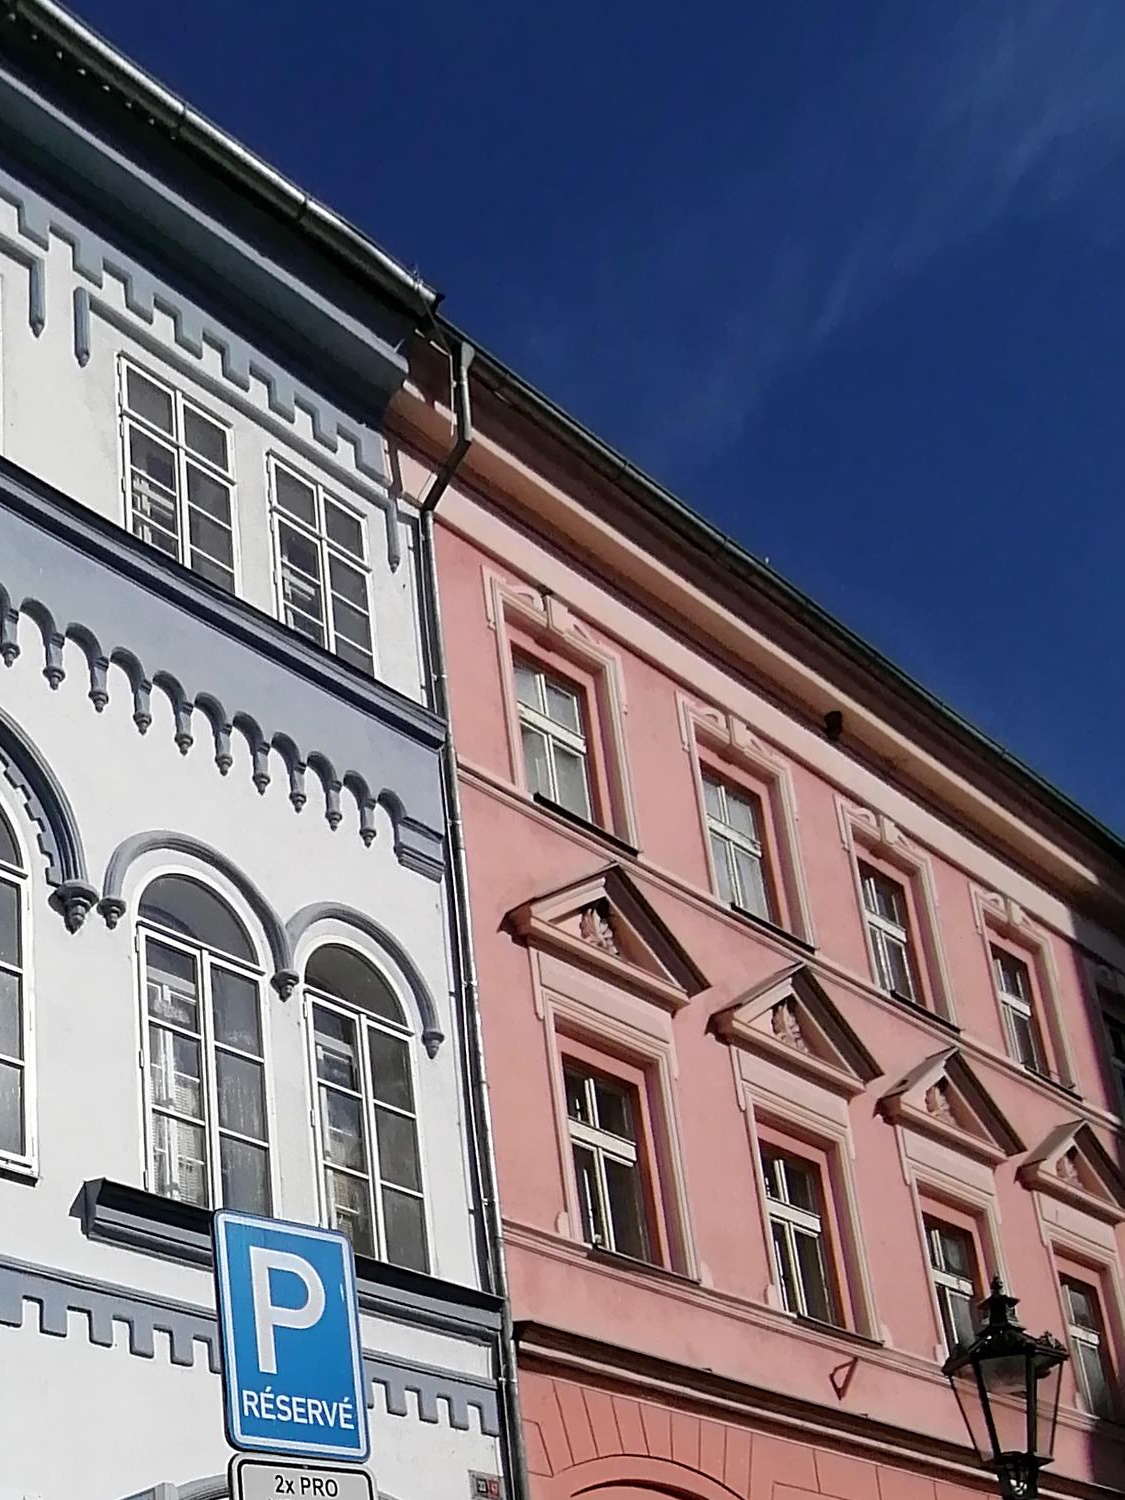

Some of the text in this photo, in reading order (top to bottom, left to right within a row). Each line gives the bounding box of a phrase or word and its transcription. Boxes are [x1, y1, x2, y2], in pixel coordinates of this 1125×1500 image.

[249, 1245, 327, 1375] P
[242, 1386, 355, 1430] RÉSERVÉ
[275, 1474, 338, 1497] 2x PRO
